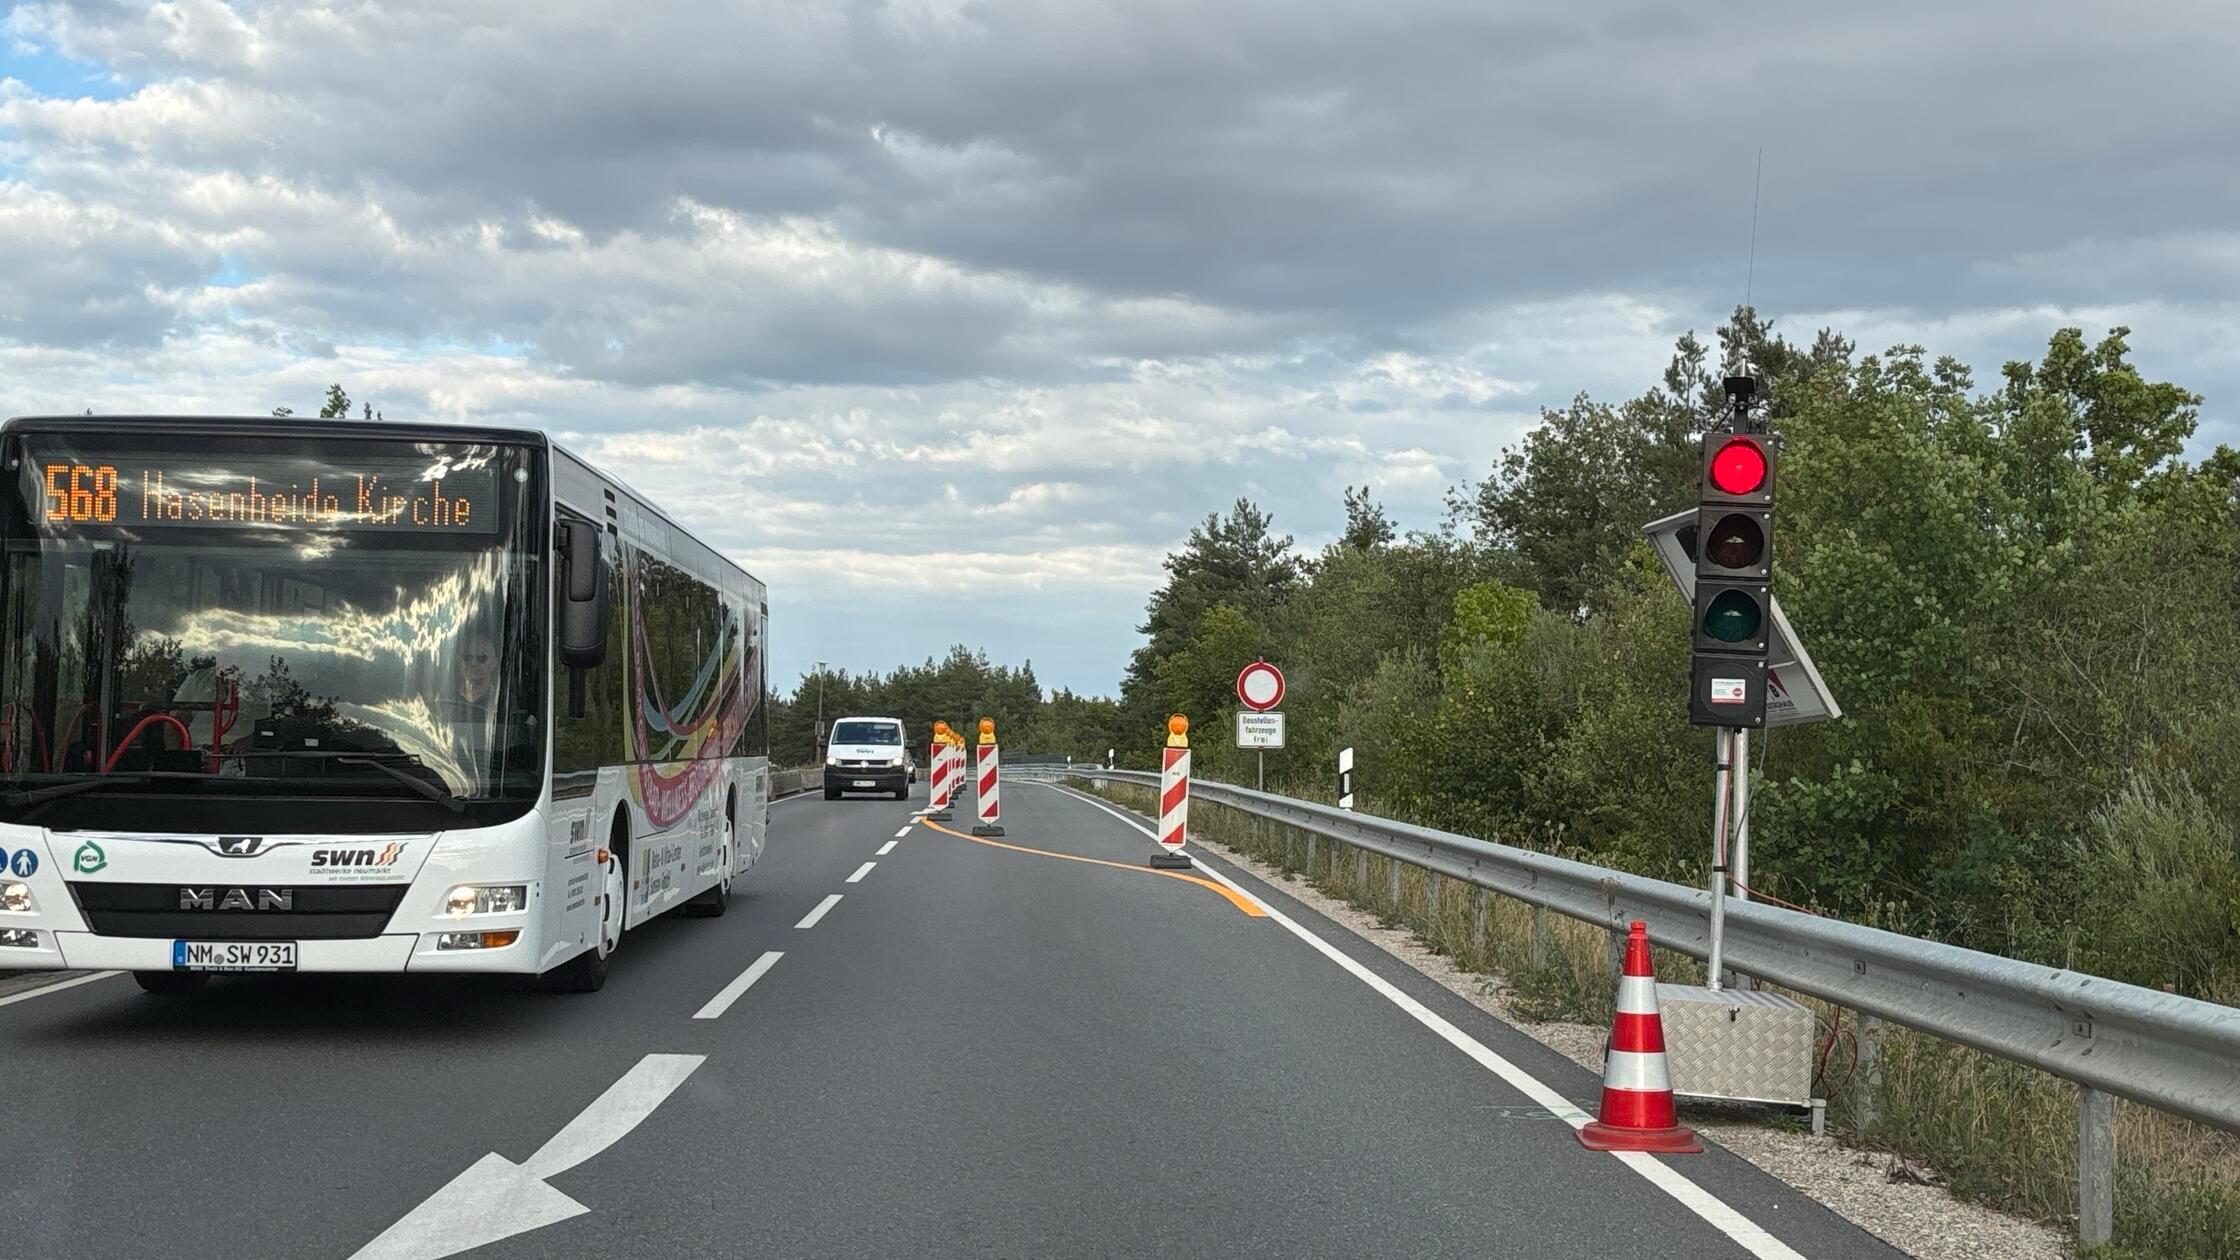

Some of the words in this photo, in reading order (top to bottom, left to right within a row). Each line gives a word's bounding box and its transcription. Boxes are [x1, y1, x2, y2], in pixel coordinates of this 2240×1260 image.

[47, 465, 118, 522] 568
[142, 470, 339, 523] Hasenheide
[357, 475, 471, 526] Kirche
[311, 850, 376, 866] swn
[180, 888, 293, 911] MAN
[187, 944, 213, 963] NM
[226, 945, 252, 964] SW
[257, 945, 294, 964] 931
